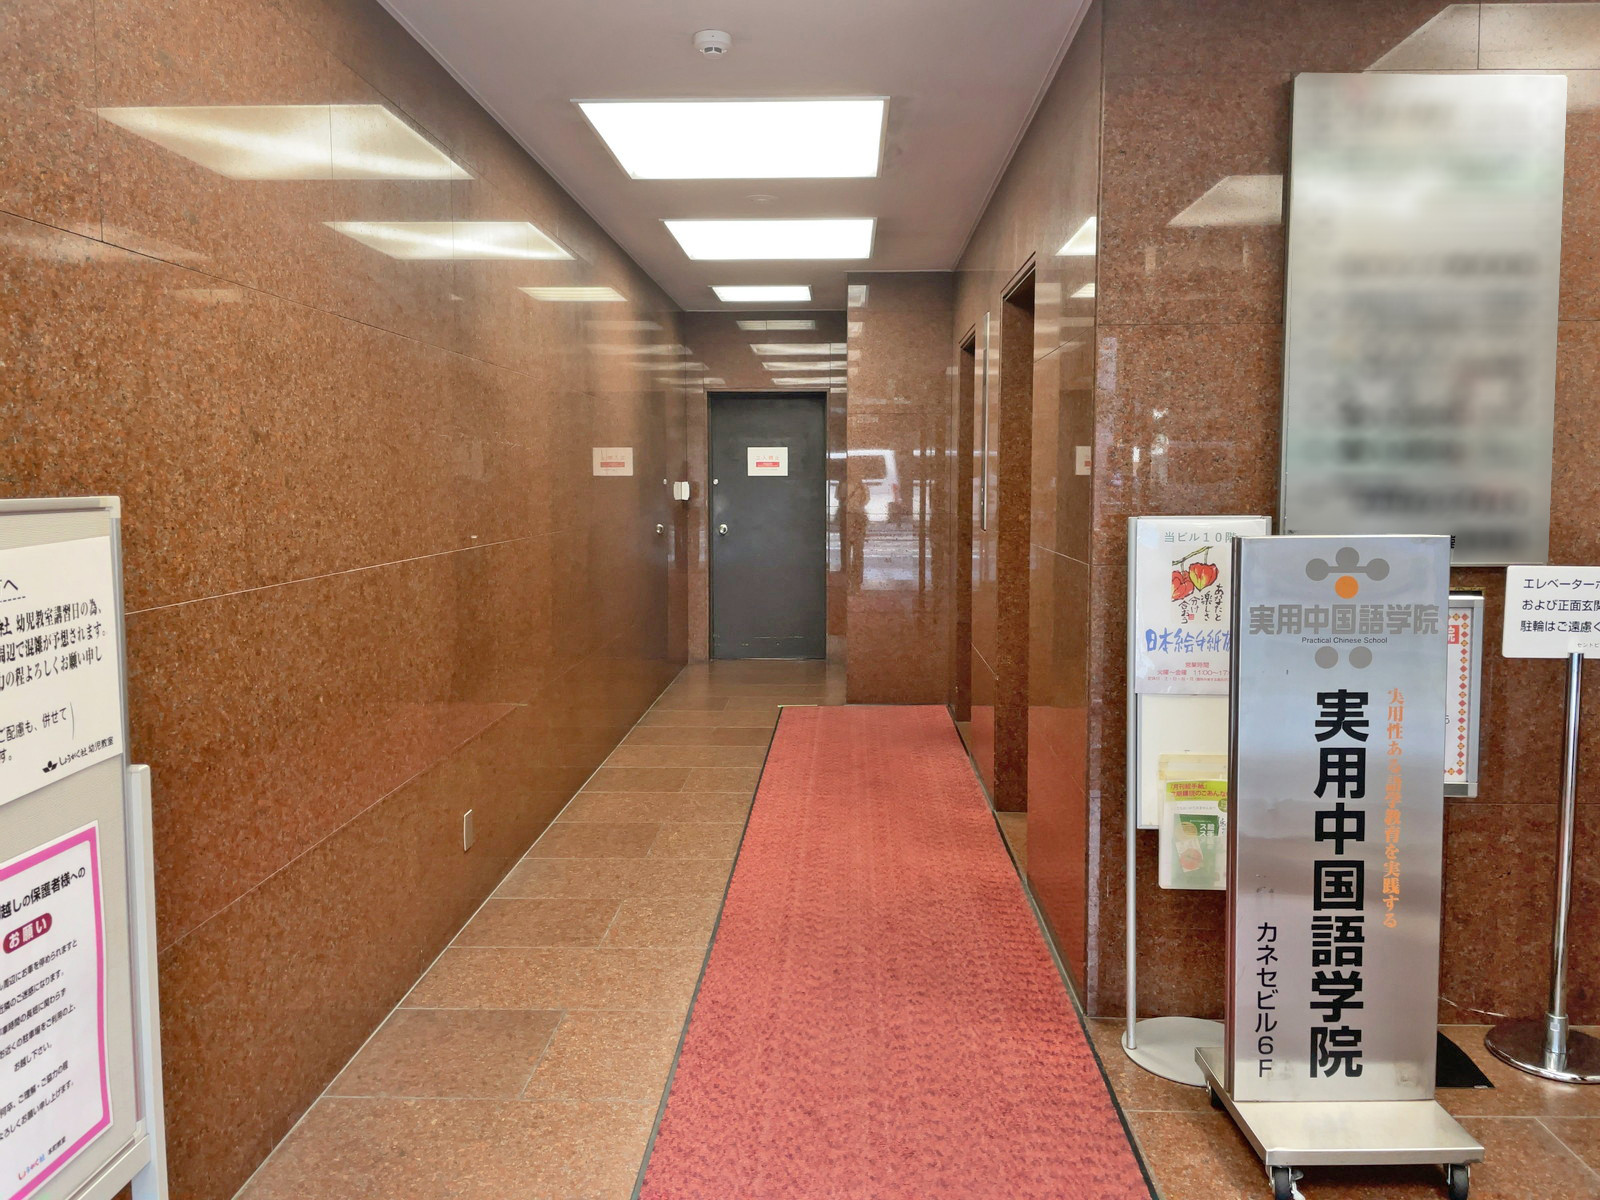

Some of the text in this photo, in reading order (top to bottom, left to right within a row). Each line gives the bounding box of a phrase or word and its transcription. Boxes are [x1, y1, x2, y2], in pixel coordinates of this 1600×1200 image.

[1249, 604, 1439, 635] 実用中国語学院
[1310, 689, 1369, 1077] 実用中国語学院
[1383, 688, 1405, 929] 実用性ある語学教育を実践する
[9, 918, 47, 949] お願い
[1255, 921, 1278, 1078] カネセビル6F
